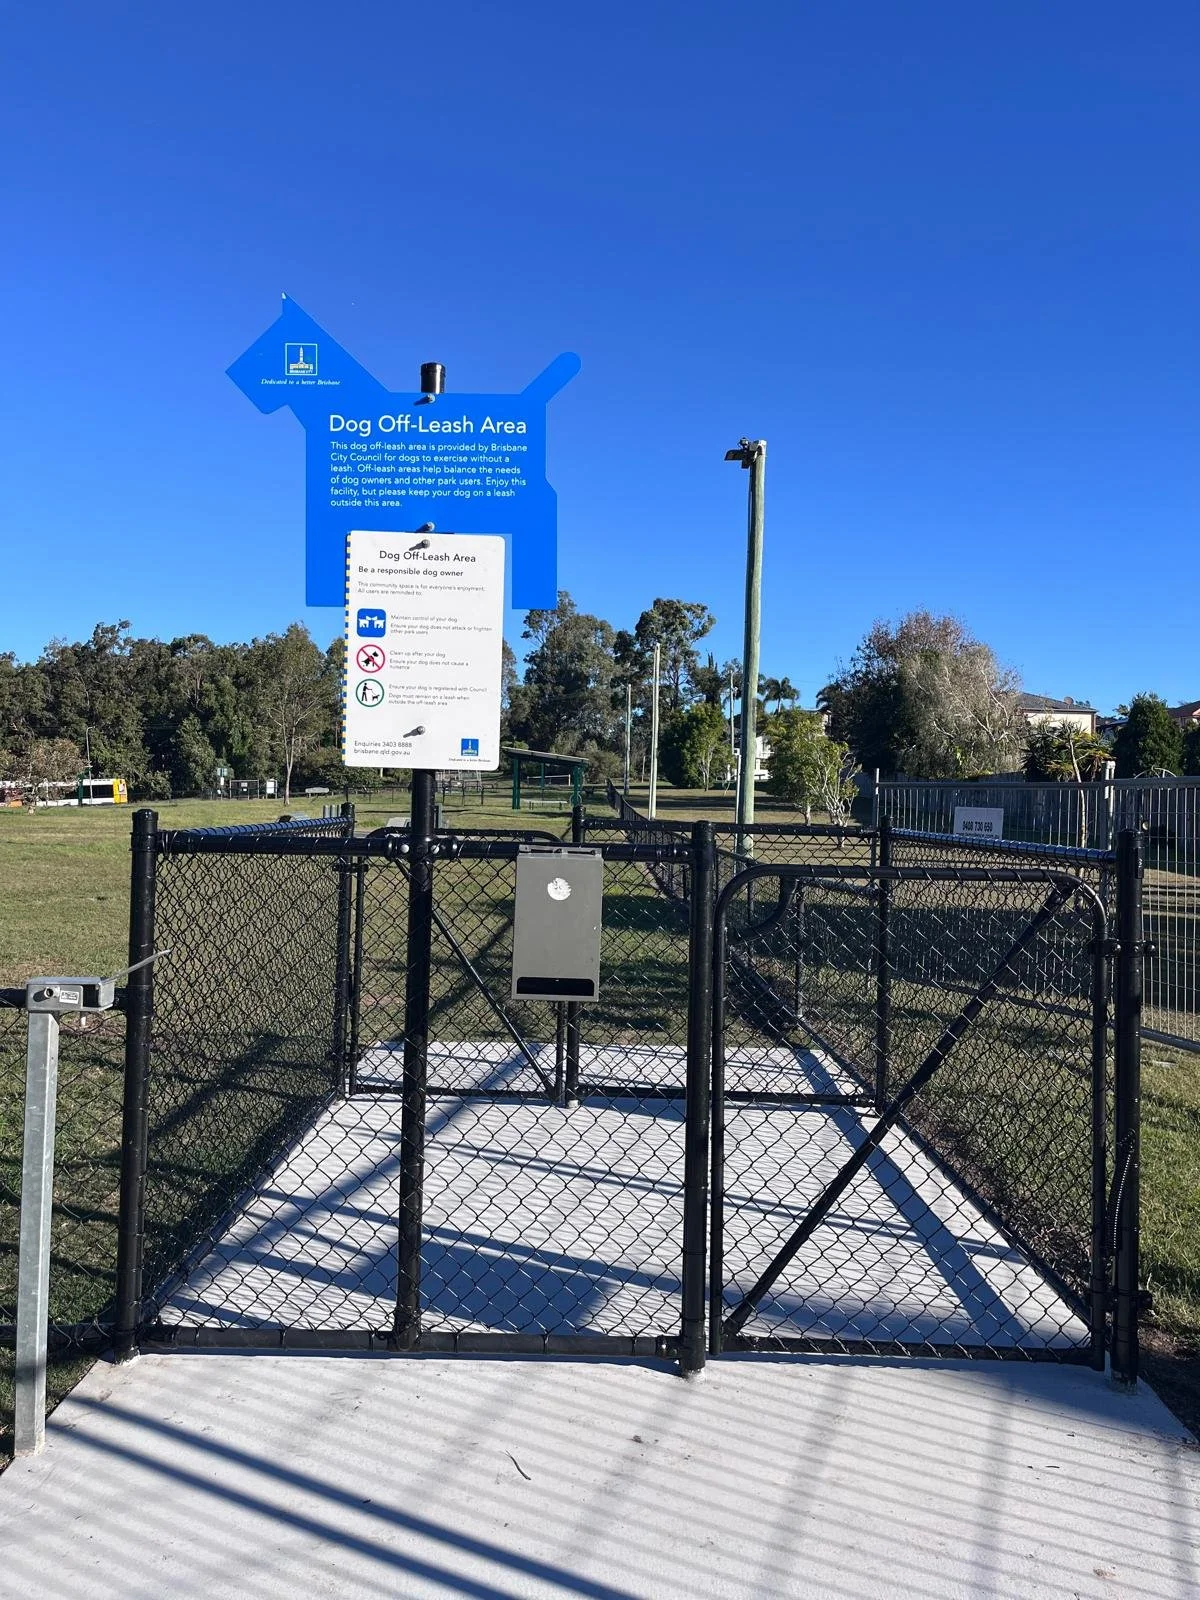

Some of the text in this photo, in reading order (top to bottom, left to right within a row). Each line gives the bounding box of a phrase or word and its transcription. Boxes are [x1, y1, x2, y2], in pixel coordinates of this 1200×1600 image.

[330, 414, 526, 438] Dog Off-Leash Area
[330, 441, 348, 450] This
[350, 441, 367, 452] dog
[369, 441, 406, 451] off-leash
[429, 442, 435, 451] is
[437, 442, 476, 453] provided
[478, 443, 489, 454] by
[491, 443, 528, 452] Brisbane
[330, 452, 348, 463] City
[349, 452, 382, 461] Council
[384, 452, 396, 462] for
[398, 453, 420, 464] dogs
[422, 454, 431, 462] to
[433, 454, 468, 463] exercise
[471, 454, 502, 463] without
[330, 464, 354, 473] leash.
[357, 463, 396, 473] Off-leash
[422, 464, 442, 474] help
[443, 464, 477, 474] balance
[479, 465, 493, 474] the
[495, 466, 521, 474] needs
[330, 474, 526, 488] of dog owners and other park users. Enjoy this
[330, 486, 359, 498] facility,
[362, 487, 376, 496] but
[379, 487, 406, 497] please
[408, 487, 430, 498] keep
[432, 489, 451, 499] your
[453, 488, 471, 499] dog
[493, 488, 516, 497] leash
[330, 498, 362, 507] outside
[364, 498, 380, 507] this
[379, 550, 476, 563] Dog Off-Leash Area
[358, 565, 368, 573] Be
[377, 567, 420, 576] responsible
[422, 568, 438, 578] dog
[435, 651, 446, 659] dog
[354, 740, 381, 748] Enquiries
[354, 748, 410, 756] brisbane.qld.gov.au
